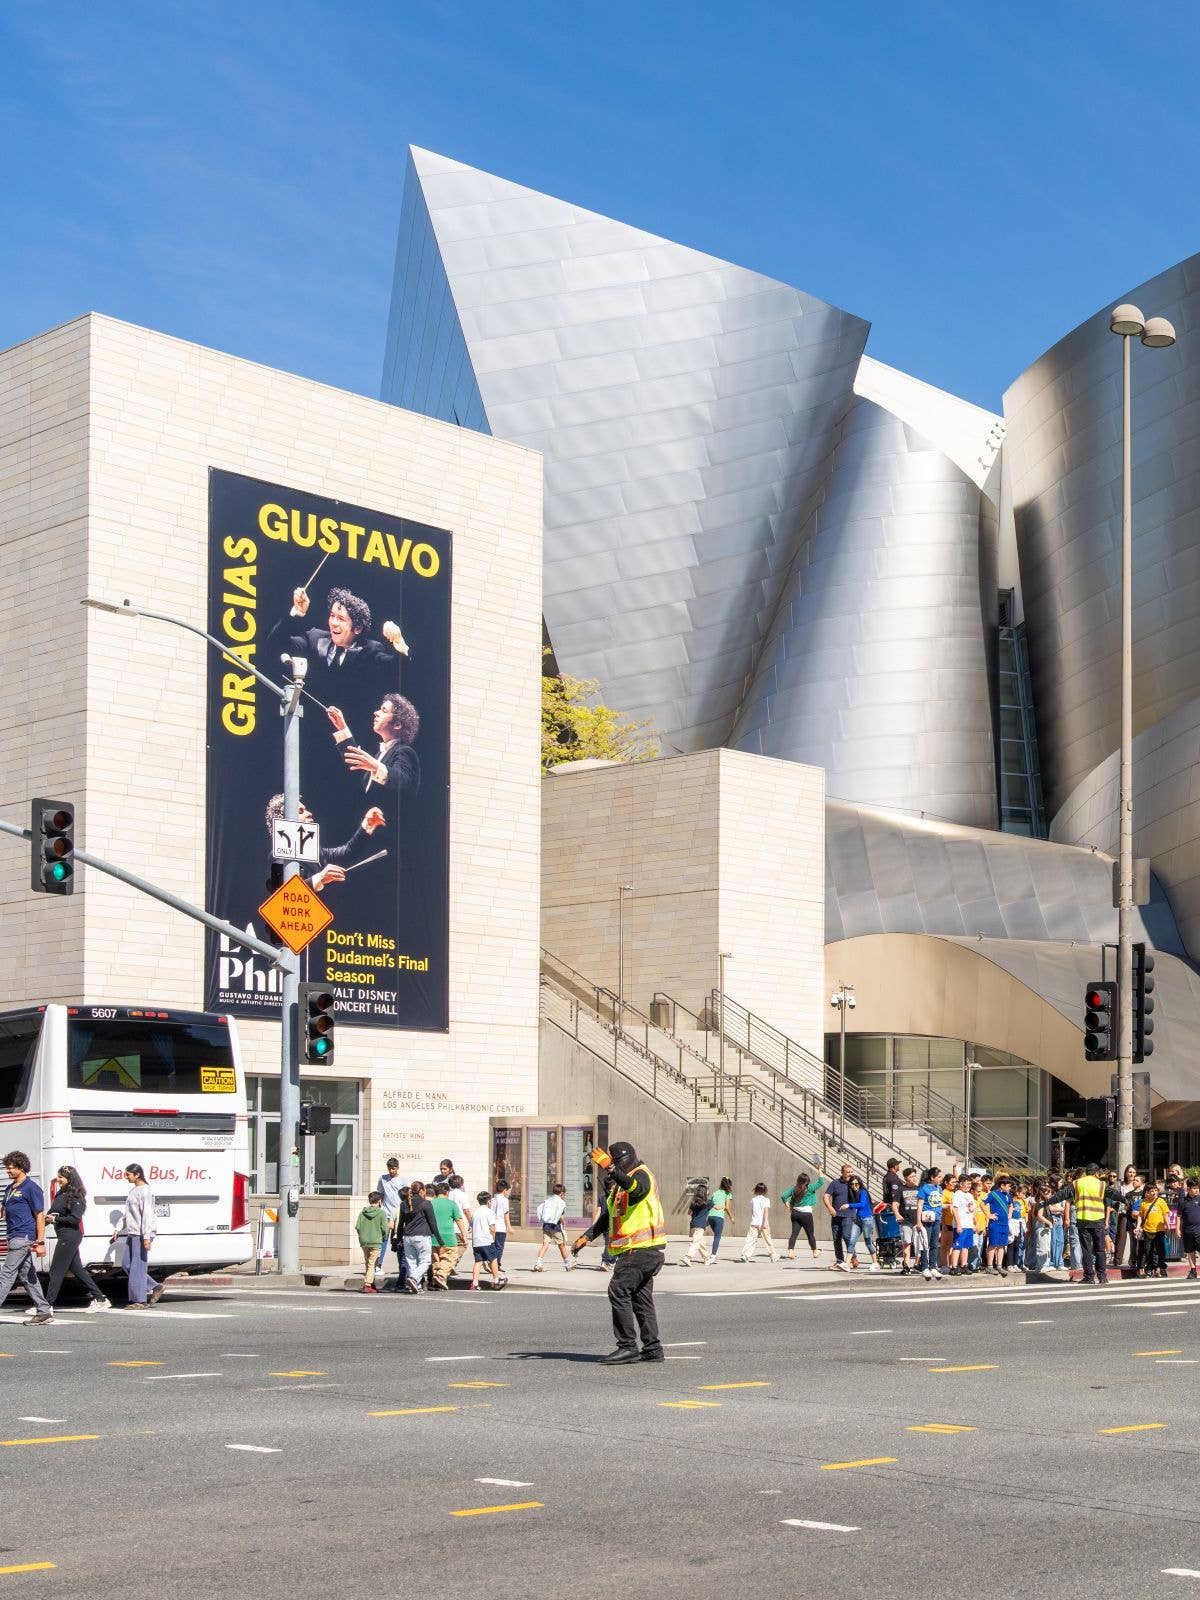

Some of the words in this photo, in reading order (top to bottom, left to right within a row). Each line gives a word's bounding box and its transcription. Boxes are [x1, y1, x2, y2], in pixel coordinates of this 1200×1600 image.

[258, 503, 440, 577] GUSTAVO
[221, 535, 257, 736] GRACIAS
[277, 847, 293, 855] ONLY
[283, 892, 310, 904] ROAD
[282, 906, 311, 918] WORK
[280, 921, 314, 932] AHEAD
[326, 930, 364, 947] Don't
[367, 934, 395, 949] Miss
[326, 949, 395, 968] Dudamel's
[398, 955, 428, 971] Final
[326, 967, 375, 984] Season
[219, 992, 252, 1000] GUSTAVO
[254, 994, 283, 1002] DUDAME
[333, 987, 355, 998] ALT
[358, 989, 397, 1001] DISNEY
[91, 1008, 117, 1019] 5607
[333, 1001, 371, 1013] ONCERT
[374, 1004, 398, 1015] HALL
[203, 1076, 235, 1085] CAUTION
[383, 1091, 413, 1100] ALFRED
[425, 1092, 448, 1100] MANN
[383, 1101, 398, 1109] LOS
[400, 1102, 435, 1110] ANGELES
[437, 1103, 494, 1112] PHILHARMONIC
[496, 1104, 525, 1113] CENTER
[149, 1165, 179, 1182] Bus,
[185, 1166, 212, 1180] Inc.
